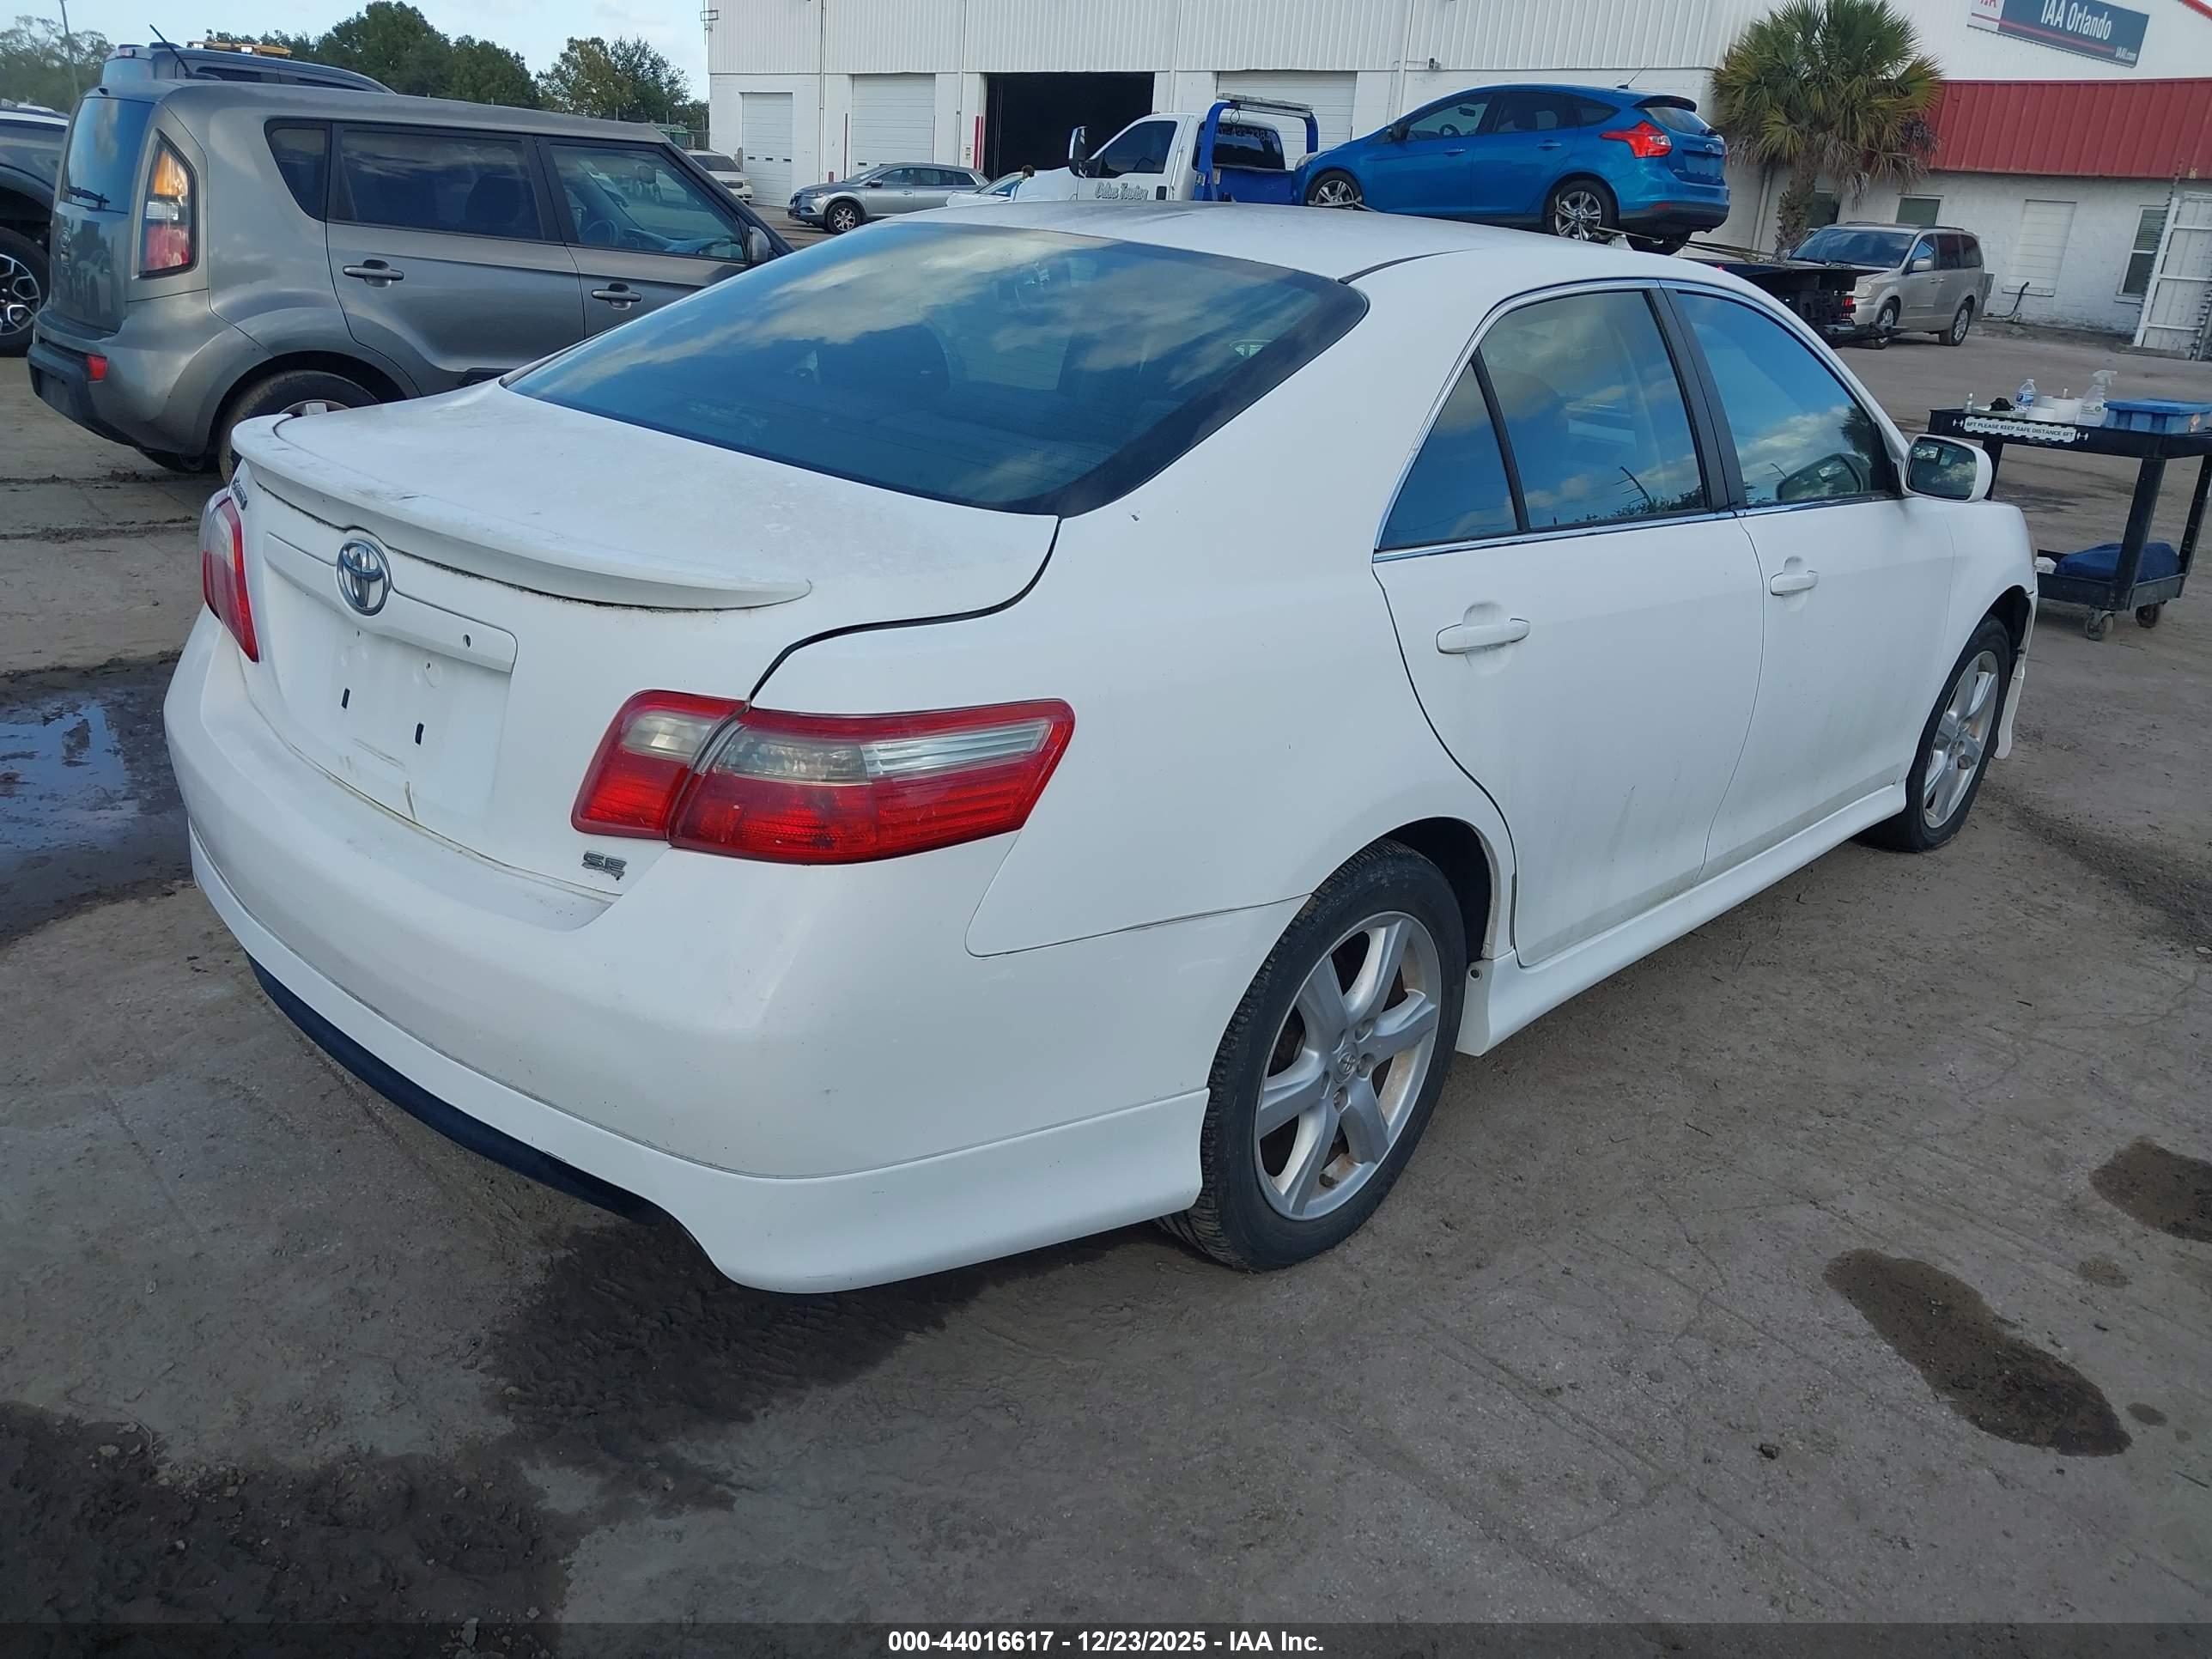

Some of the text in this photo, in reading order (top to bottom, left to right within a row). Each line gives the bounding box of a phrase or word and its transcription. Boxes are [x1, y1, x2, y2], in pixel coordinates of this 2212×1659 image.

[2040, 0, 2112, 40] IAA Orlando
[2032, 428, 2062, 436] DISTANCE
[582, 851, 627, 877] SE
